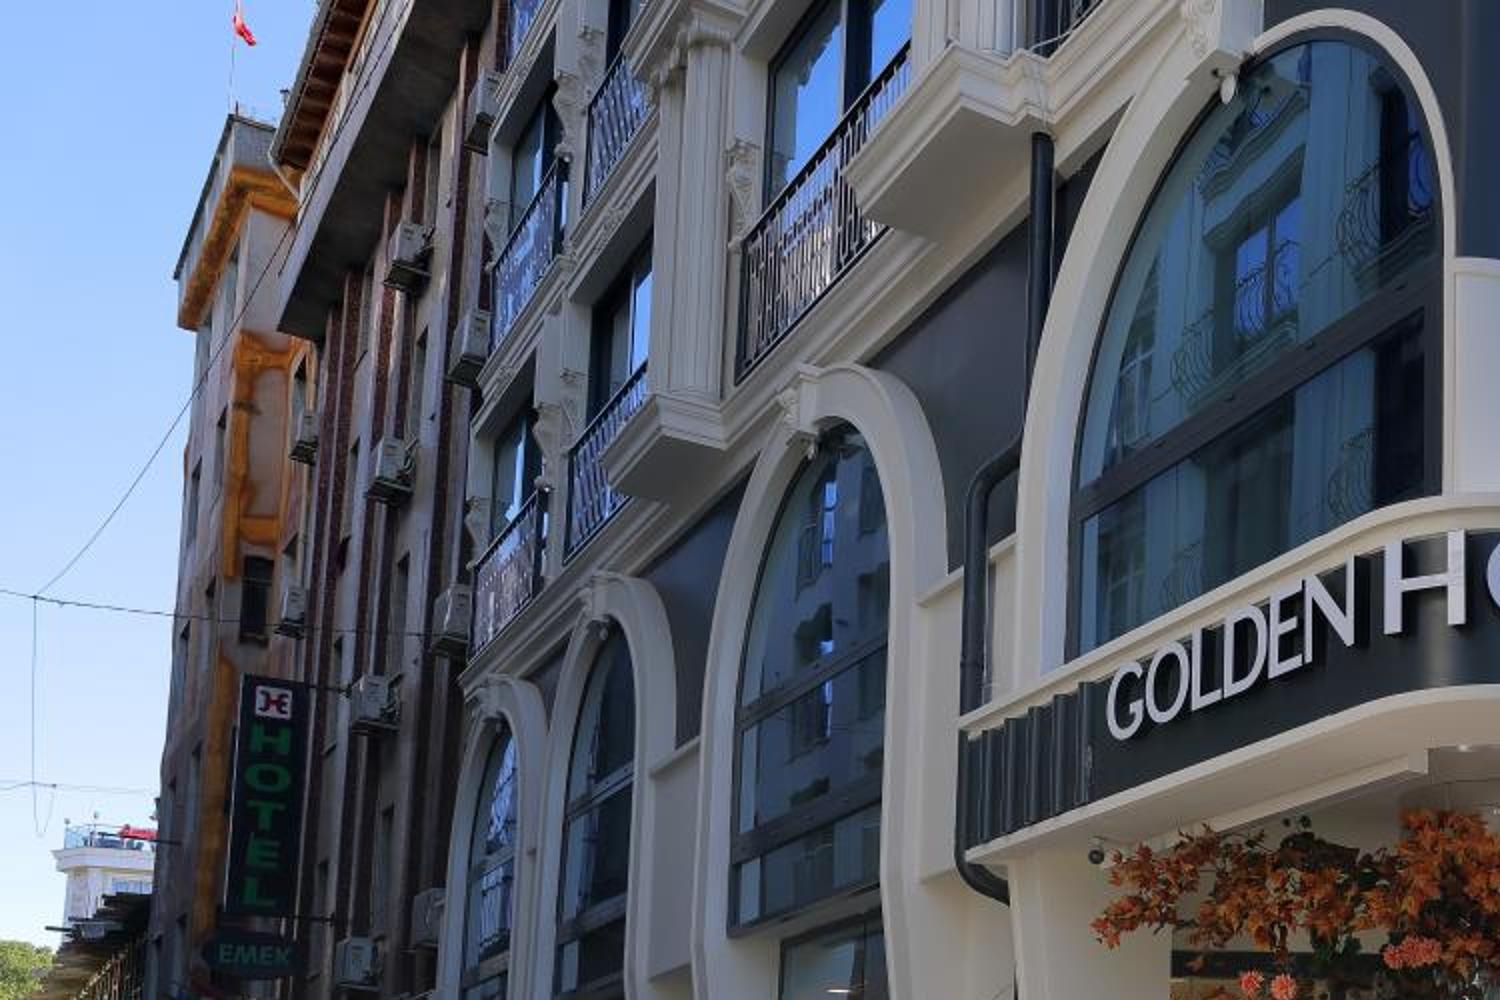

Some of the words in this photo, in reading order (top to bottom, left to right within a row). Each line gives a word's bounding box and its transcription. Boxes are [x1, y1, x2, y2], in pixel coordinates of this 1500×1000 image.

[1106, 553, 1355, 741] GOLDEN
[241, 722, 292, 907] HOTEL
[218, 943, 291, 965] EMEK
